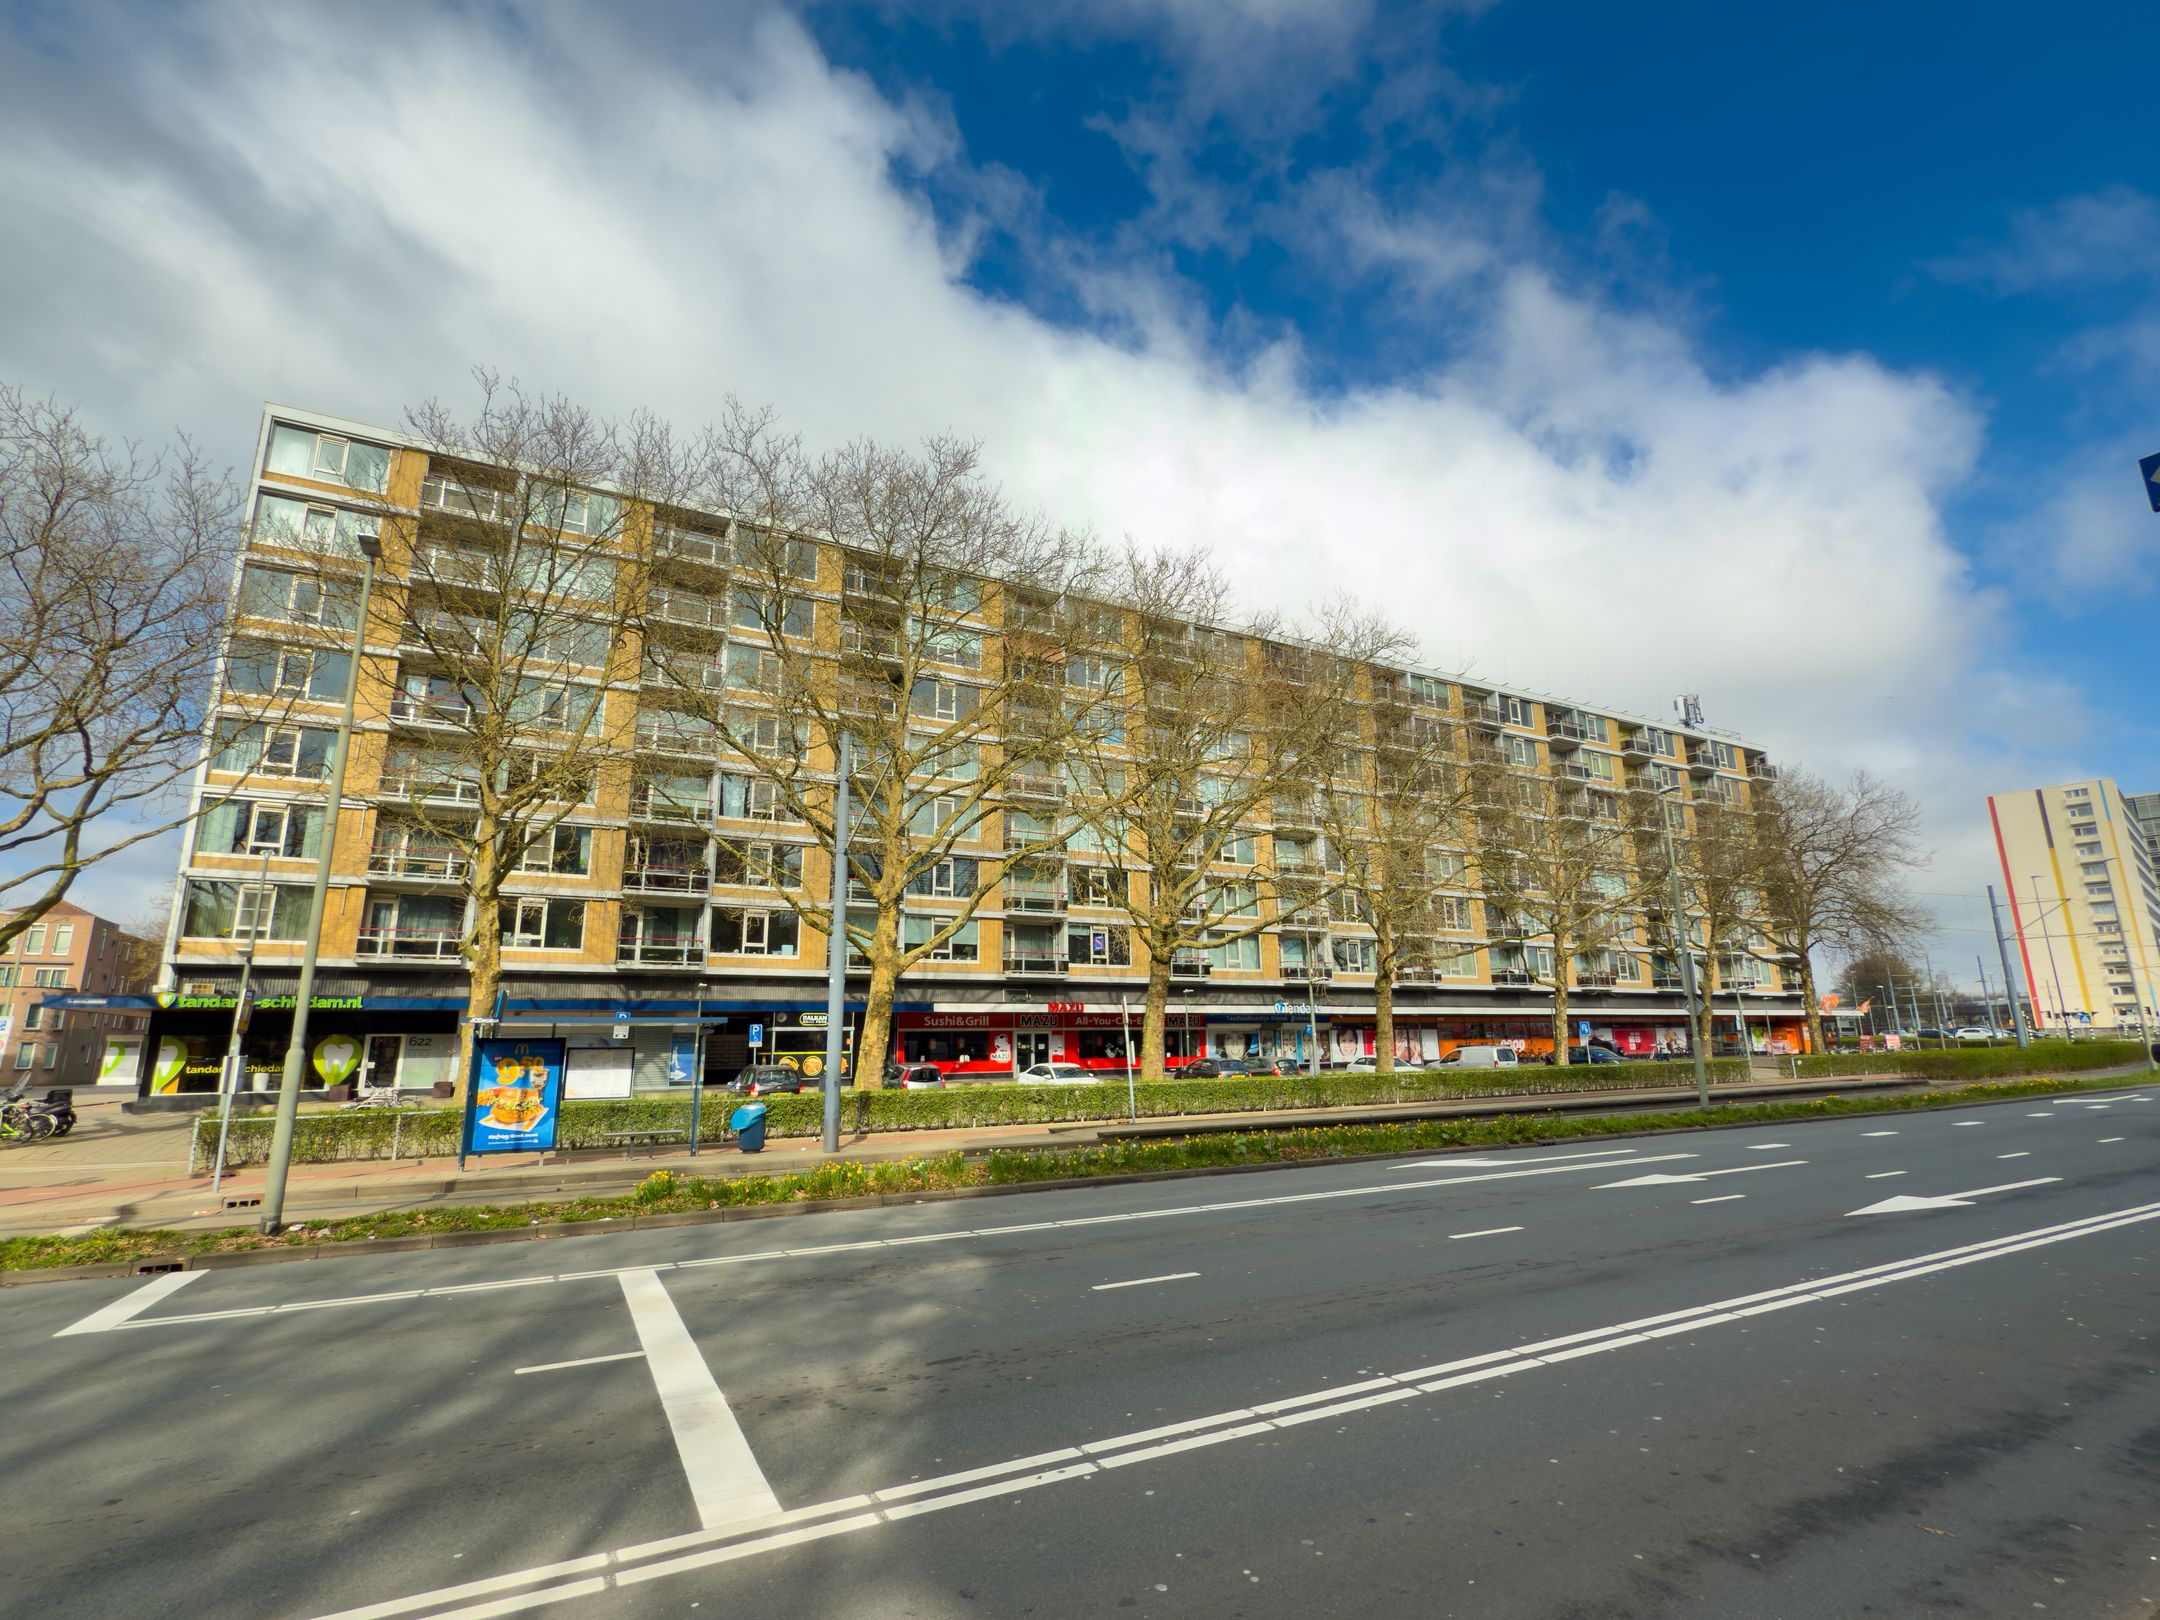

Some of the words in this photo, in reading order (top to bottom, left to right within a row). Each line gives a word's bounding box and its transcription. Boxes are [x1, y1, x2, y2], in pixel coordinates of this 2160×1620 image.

[178, 995, 363, 1009] tandar-schidam.nl
[1047, 1001, 1084, 1012] MAZU
[1283, 1002, 1322, 1013] Tandats
[924, 1016, 989, 1026] Sushi&Grill
[1020, 1015, 1059, 1027] MAZU
[1167, 1014, 1200, 1026] MAZU
[752, 1026, 760, 1035] P
[408, 1036, 432, 1046] 622
